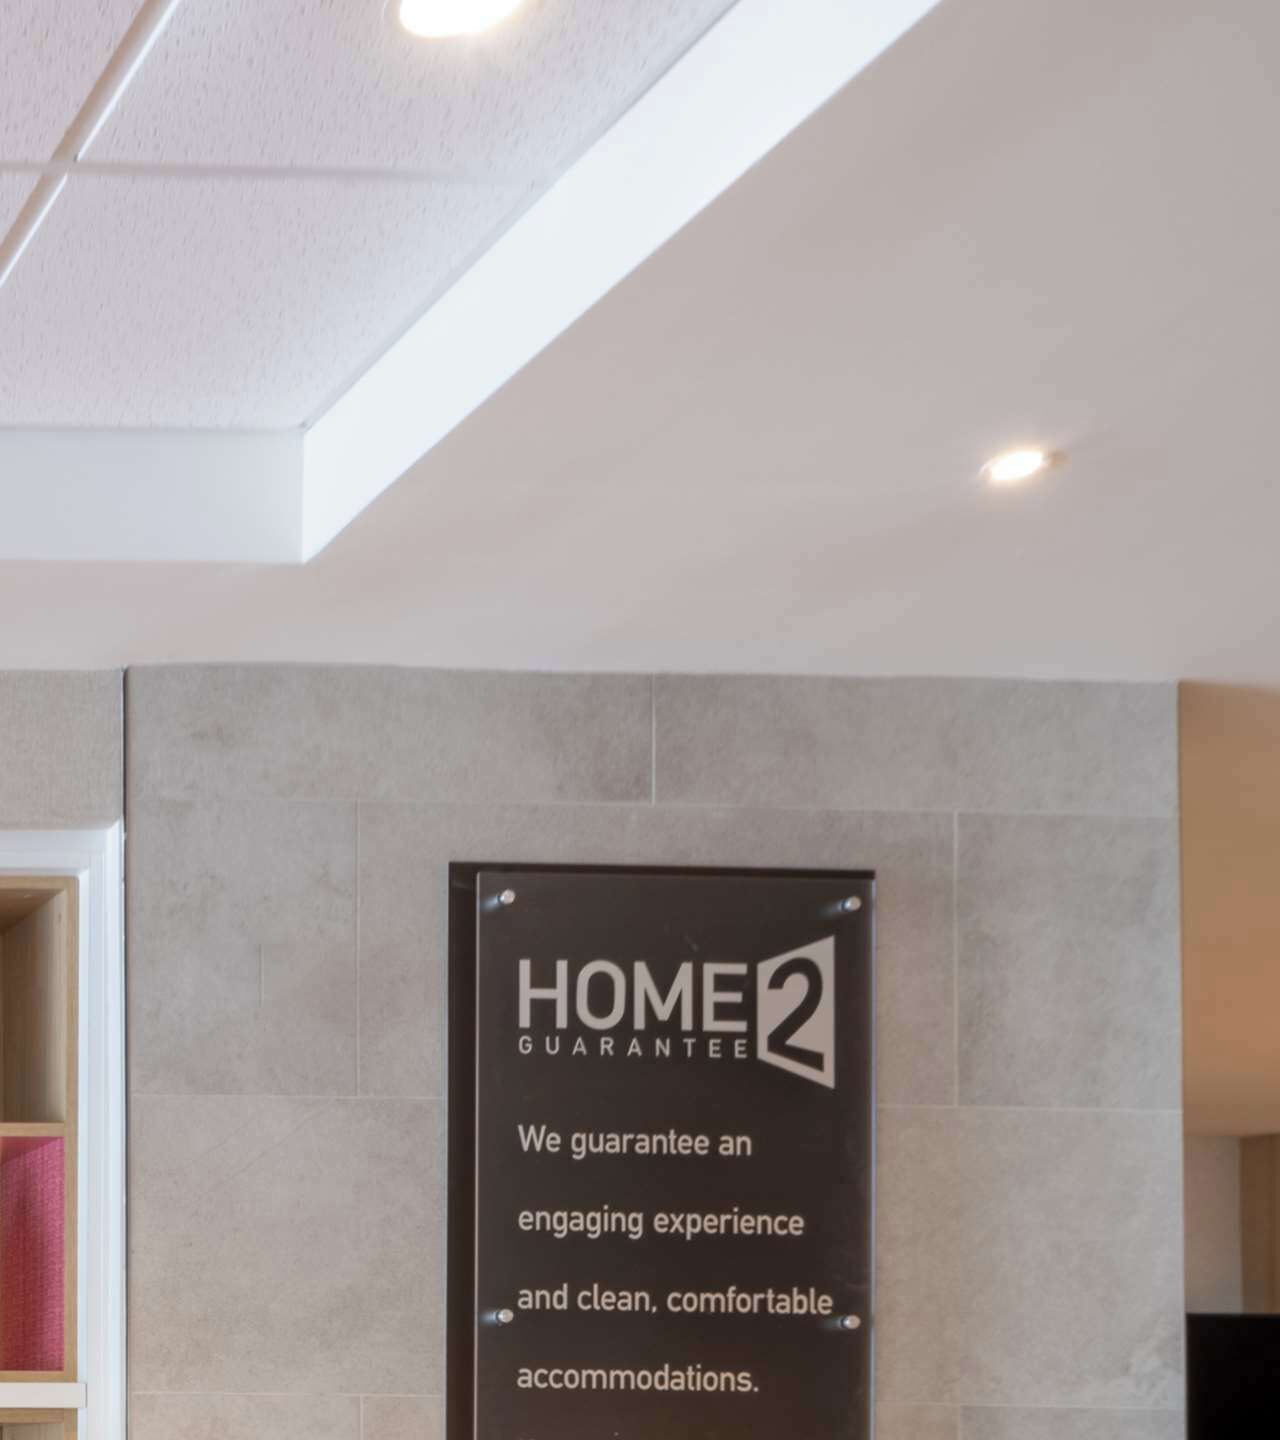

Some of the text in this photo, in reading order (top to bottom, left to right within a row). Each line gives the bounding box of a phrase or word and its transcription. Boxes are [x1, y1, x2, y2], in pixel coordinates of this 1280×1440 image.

[518, 956, 825, 1073] HOME 2
[518, 1035, 748, 1059] GUARANTEE
[518, 1124, 752, 1160] We guarantee an
[518, 1205, 804, 1240] engaging experience
[517, 1283, 834, 1315] and clean, comfortable
[516, 1363, 759, 1392] accommodations.
